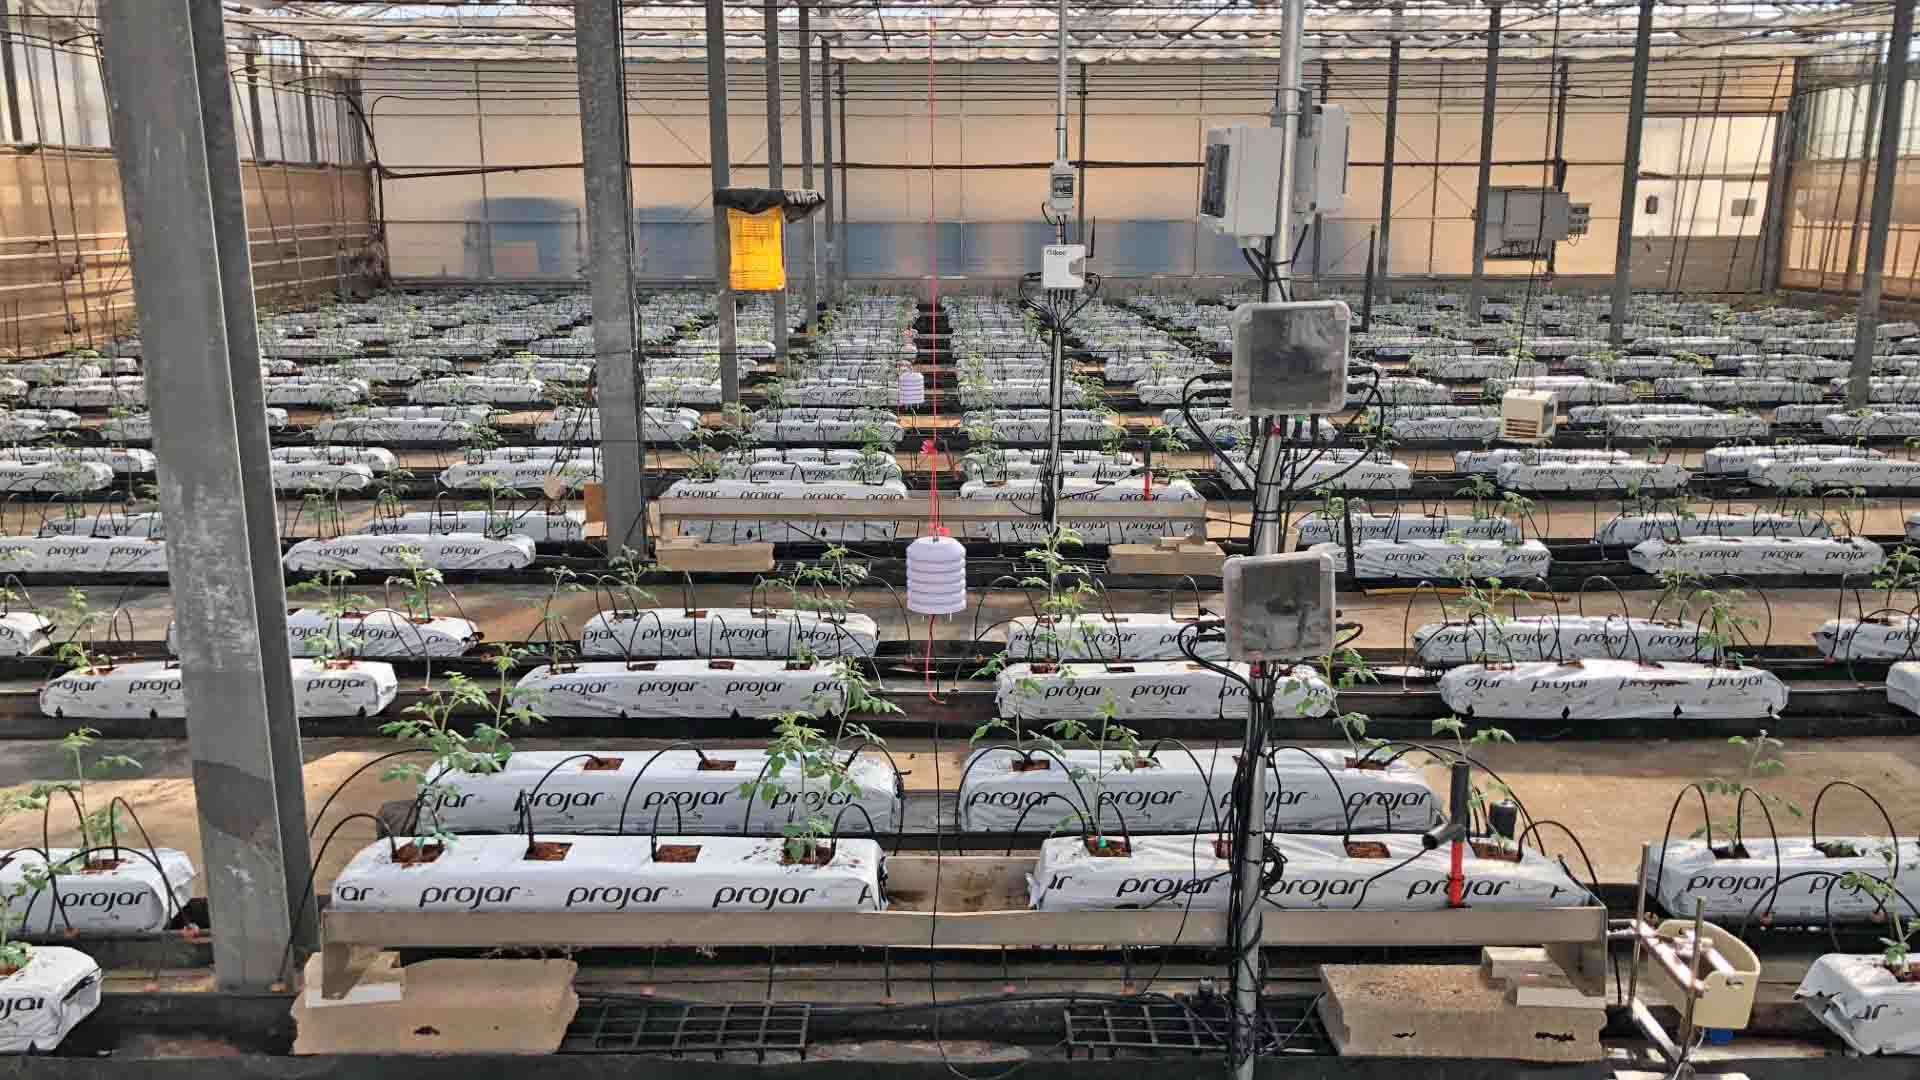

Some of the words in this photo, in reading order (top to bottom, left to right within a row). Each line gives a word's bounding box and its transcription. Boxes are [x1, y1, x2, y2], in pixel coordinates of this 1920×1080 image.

[1824, 551, 1870, 561] projar
[642, 627, 696, 642] projar
[720, 627, 773, 642] projar
[128, 679, 182, 694] proja
[550, 680, 613, 696] projar
[638, 680, 701, 697] projar
[725, 680, 786, 697] projar
[1131, 683, 1192, 699] projar
[642, 790, 731, 812] projar
[968, 790, 1058, 810] projar
[1098, 790, 1183, 811] projar
[1346, 791, 1432, 811] projar
[1117, 878, 1220, 901] projar
[1263, 878, 1364, 903] projar
[1686, 875, 1777, 895] projar
[62, 890, 148, 912] projar
[418, 885, 522, 910] projar
[566, 886, 668, 911] projar
[712, 886, 816, 911] projar
